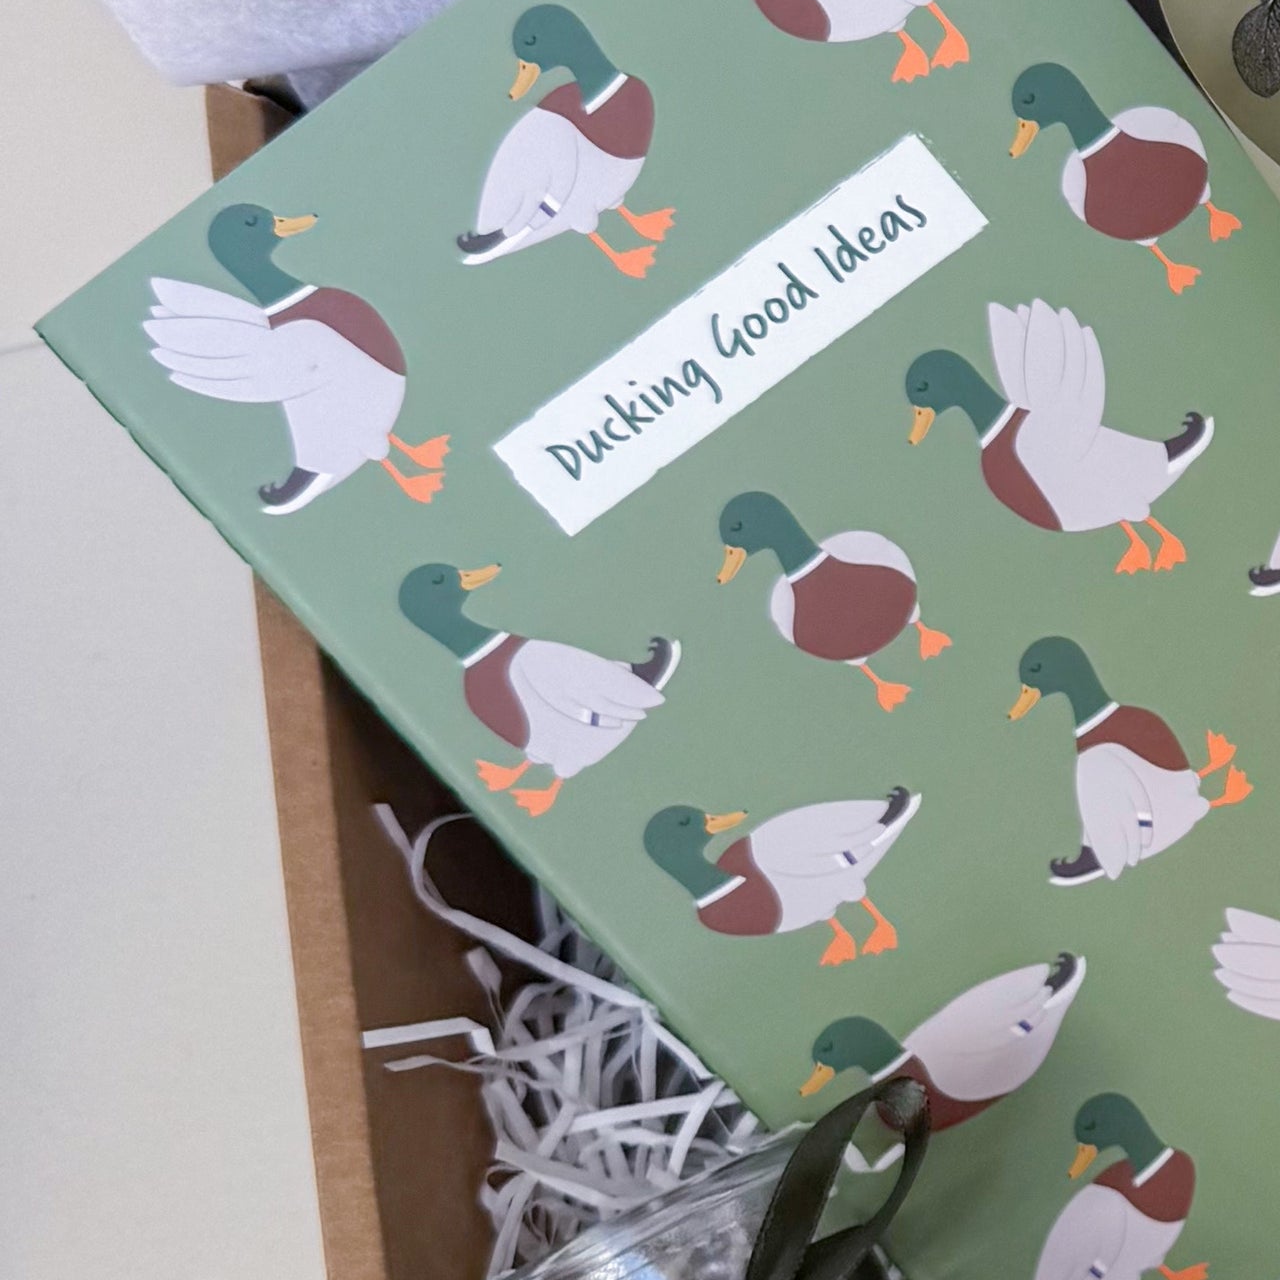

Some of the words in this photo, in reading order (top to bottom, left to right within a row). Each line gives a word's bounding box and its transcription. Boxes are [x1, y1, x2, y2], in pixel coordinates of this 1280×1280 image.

[546, 358, 722, 481] Ducking
[711, 262, 819, 358] Good
[815, 194, 928, 283] Ideas
